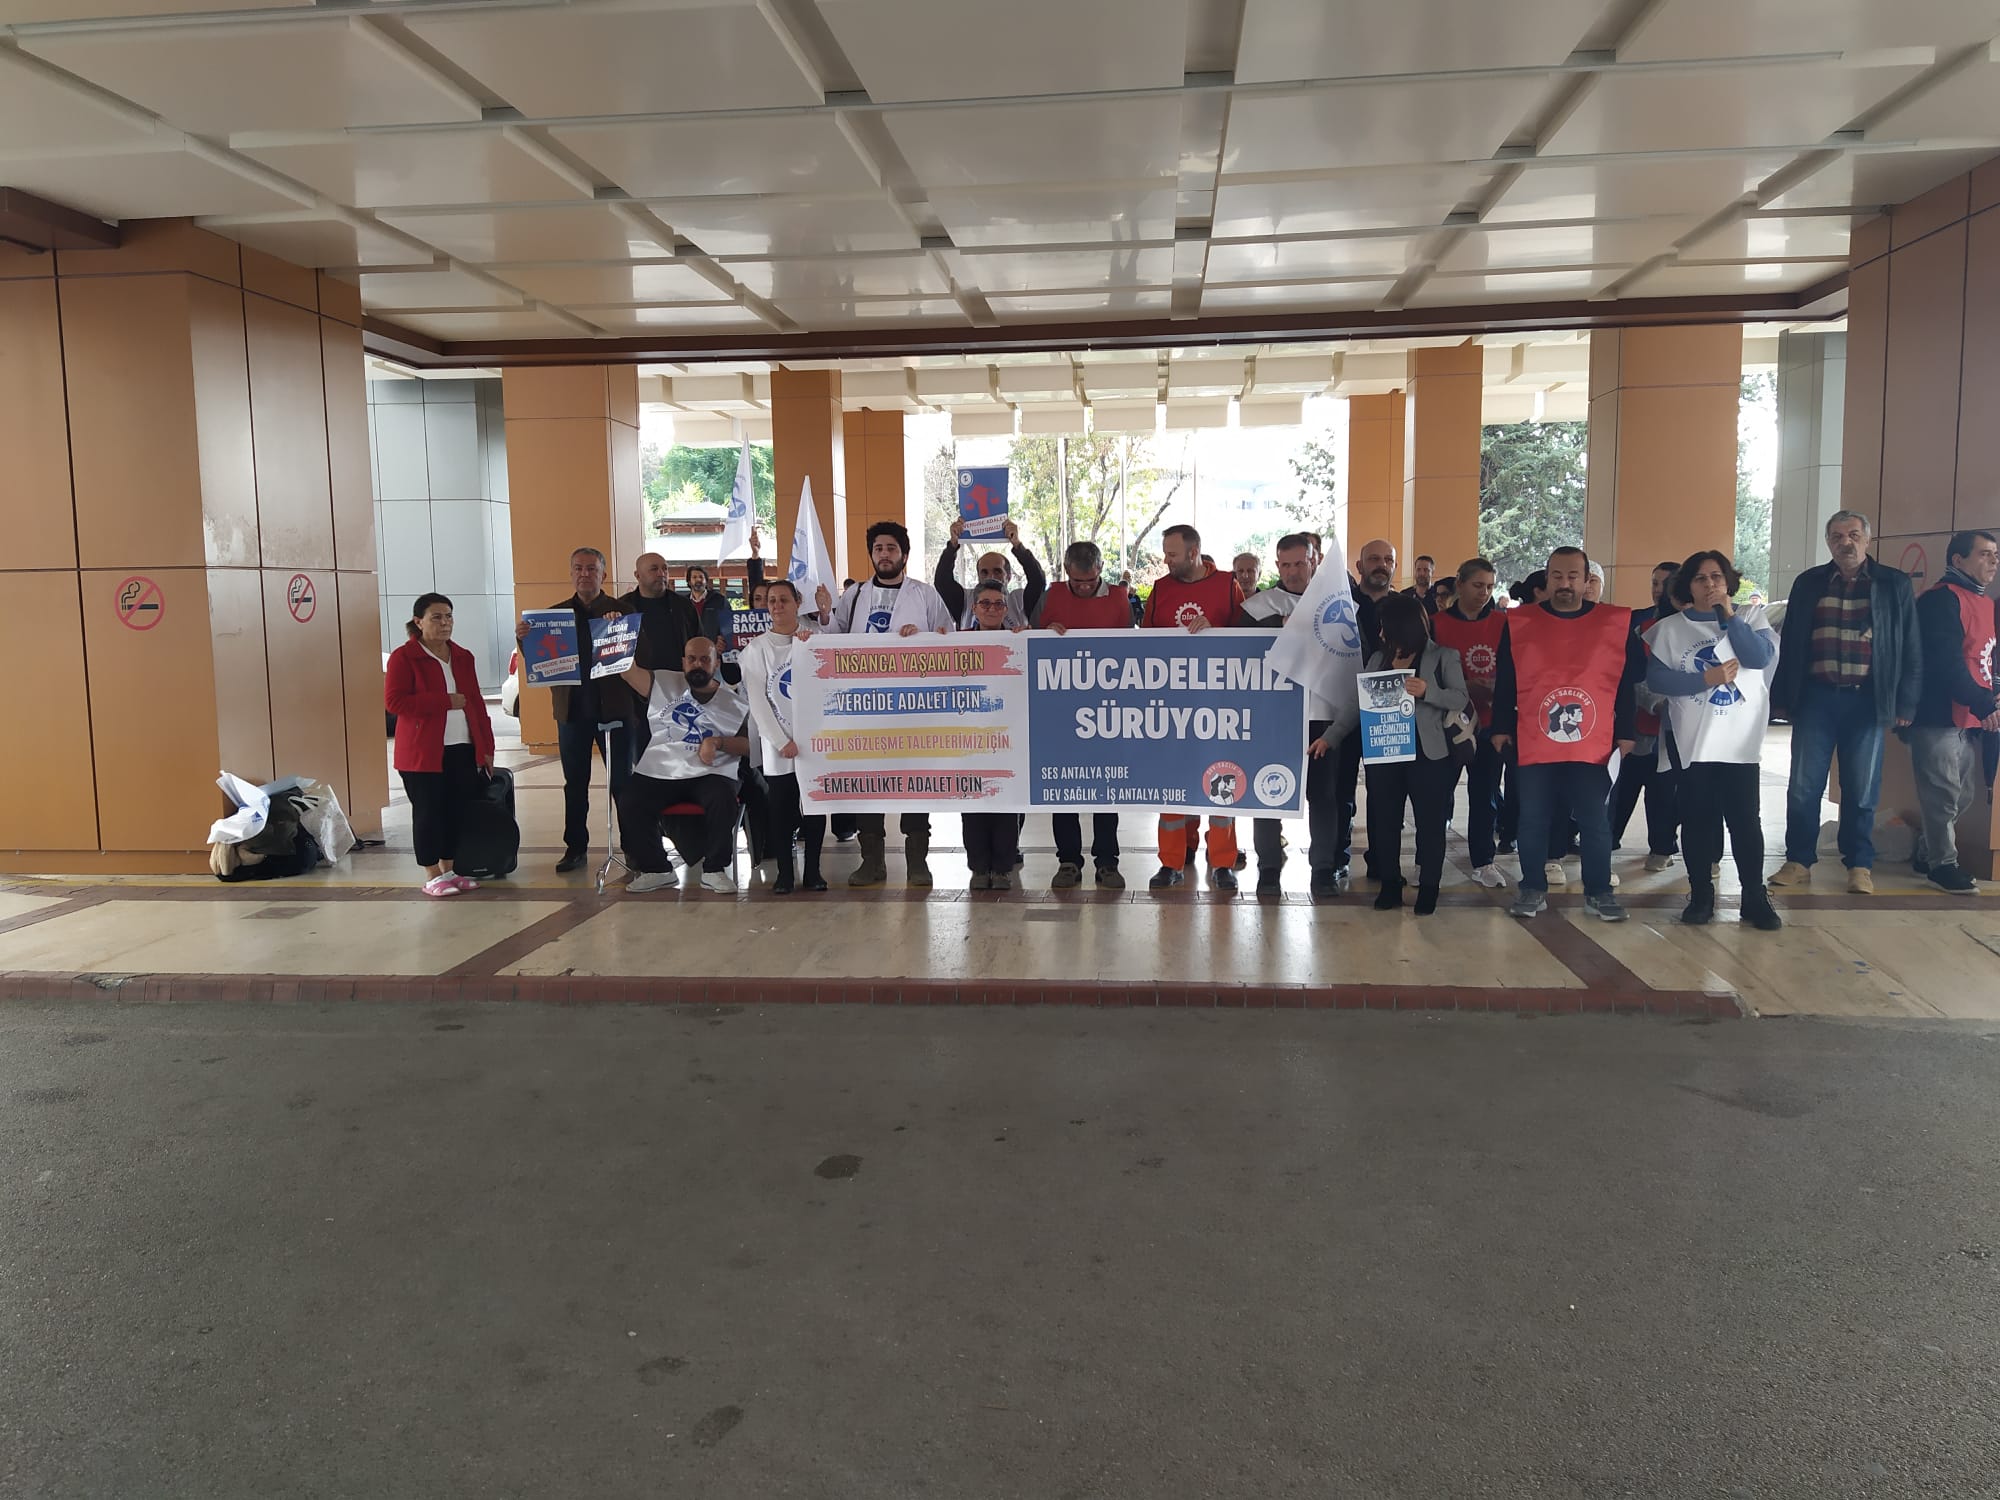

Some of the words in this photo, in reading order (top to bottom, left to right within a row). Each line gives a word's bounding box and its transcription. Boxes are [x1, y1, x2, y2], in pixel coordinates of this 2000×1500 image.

[834, 650, 897, 674] İNSANCA
[901, 651, 950, 677] YAŞAM
[953, 649, 985, 676] İÇİN
[1037, 650, 1294, 691] MÜCADELEMİZ
[836, 688, 895, 712] VERGİDE
[898, 691, 948, 710] ADALET
[951, 688, 981, 715] İÇİN
[1075, 699, 1251, 740] SÜRÜYOR!
[811, 736, 844, 753] TOPLU
[848, 733, 904, 754] SÖZLEŞME
[907, 733, 983, 750] TALEPLERİMİZ
[986, 733, 1010, 753] İÇİN
[823, 774, 903, 794] EMEKLİLİKTE
[907, 776, 952, 793] ADALET
[956, 773, 982, 797] İÇİN
[1041, 766, 1058, 780] SES
[1061, 766, 1102, 780] ANTALYA
[1105, 766, 1129, 782] ŞUBE
[1043, 788, 1061, 801] DEV
[1063, 786, 1098, 801] SAĞLIK
[1107, 786, 1116, 805] İŞ
[1119, 788, 1160, 801] ANTALYA
[1162, 788, 1187, 805] ŞUBE
